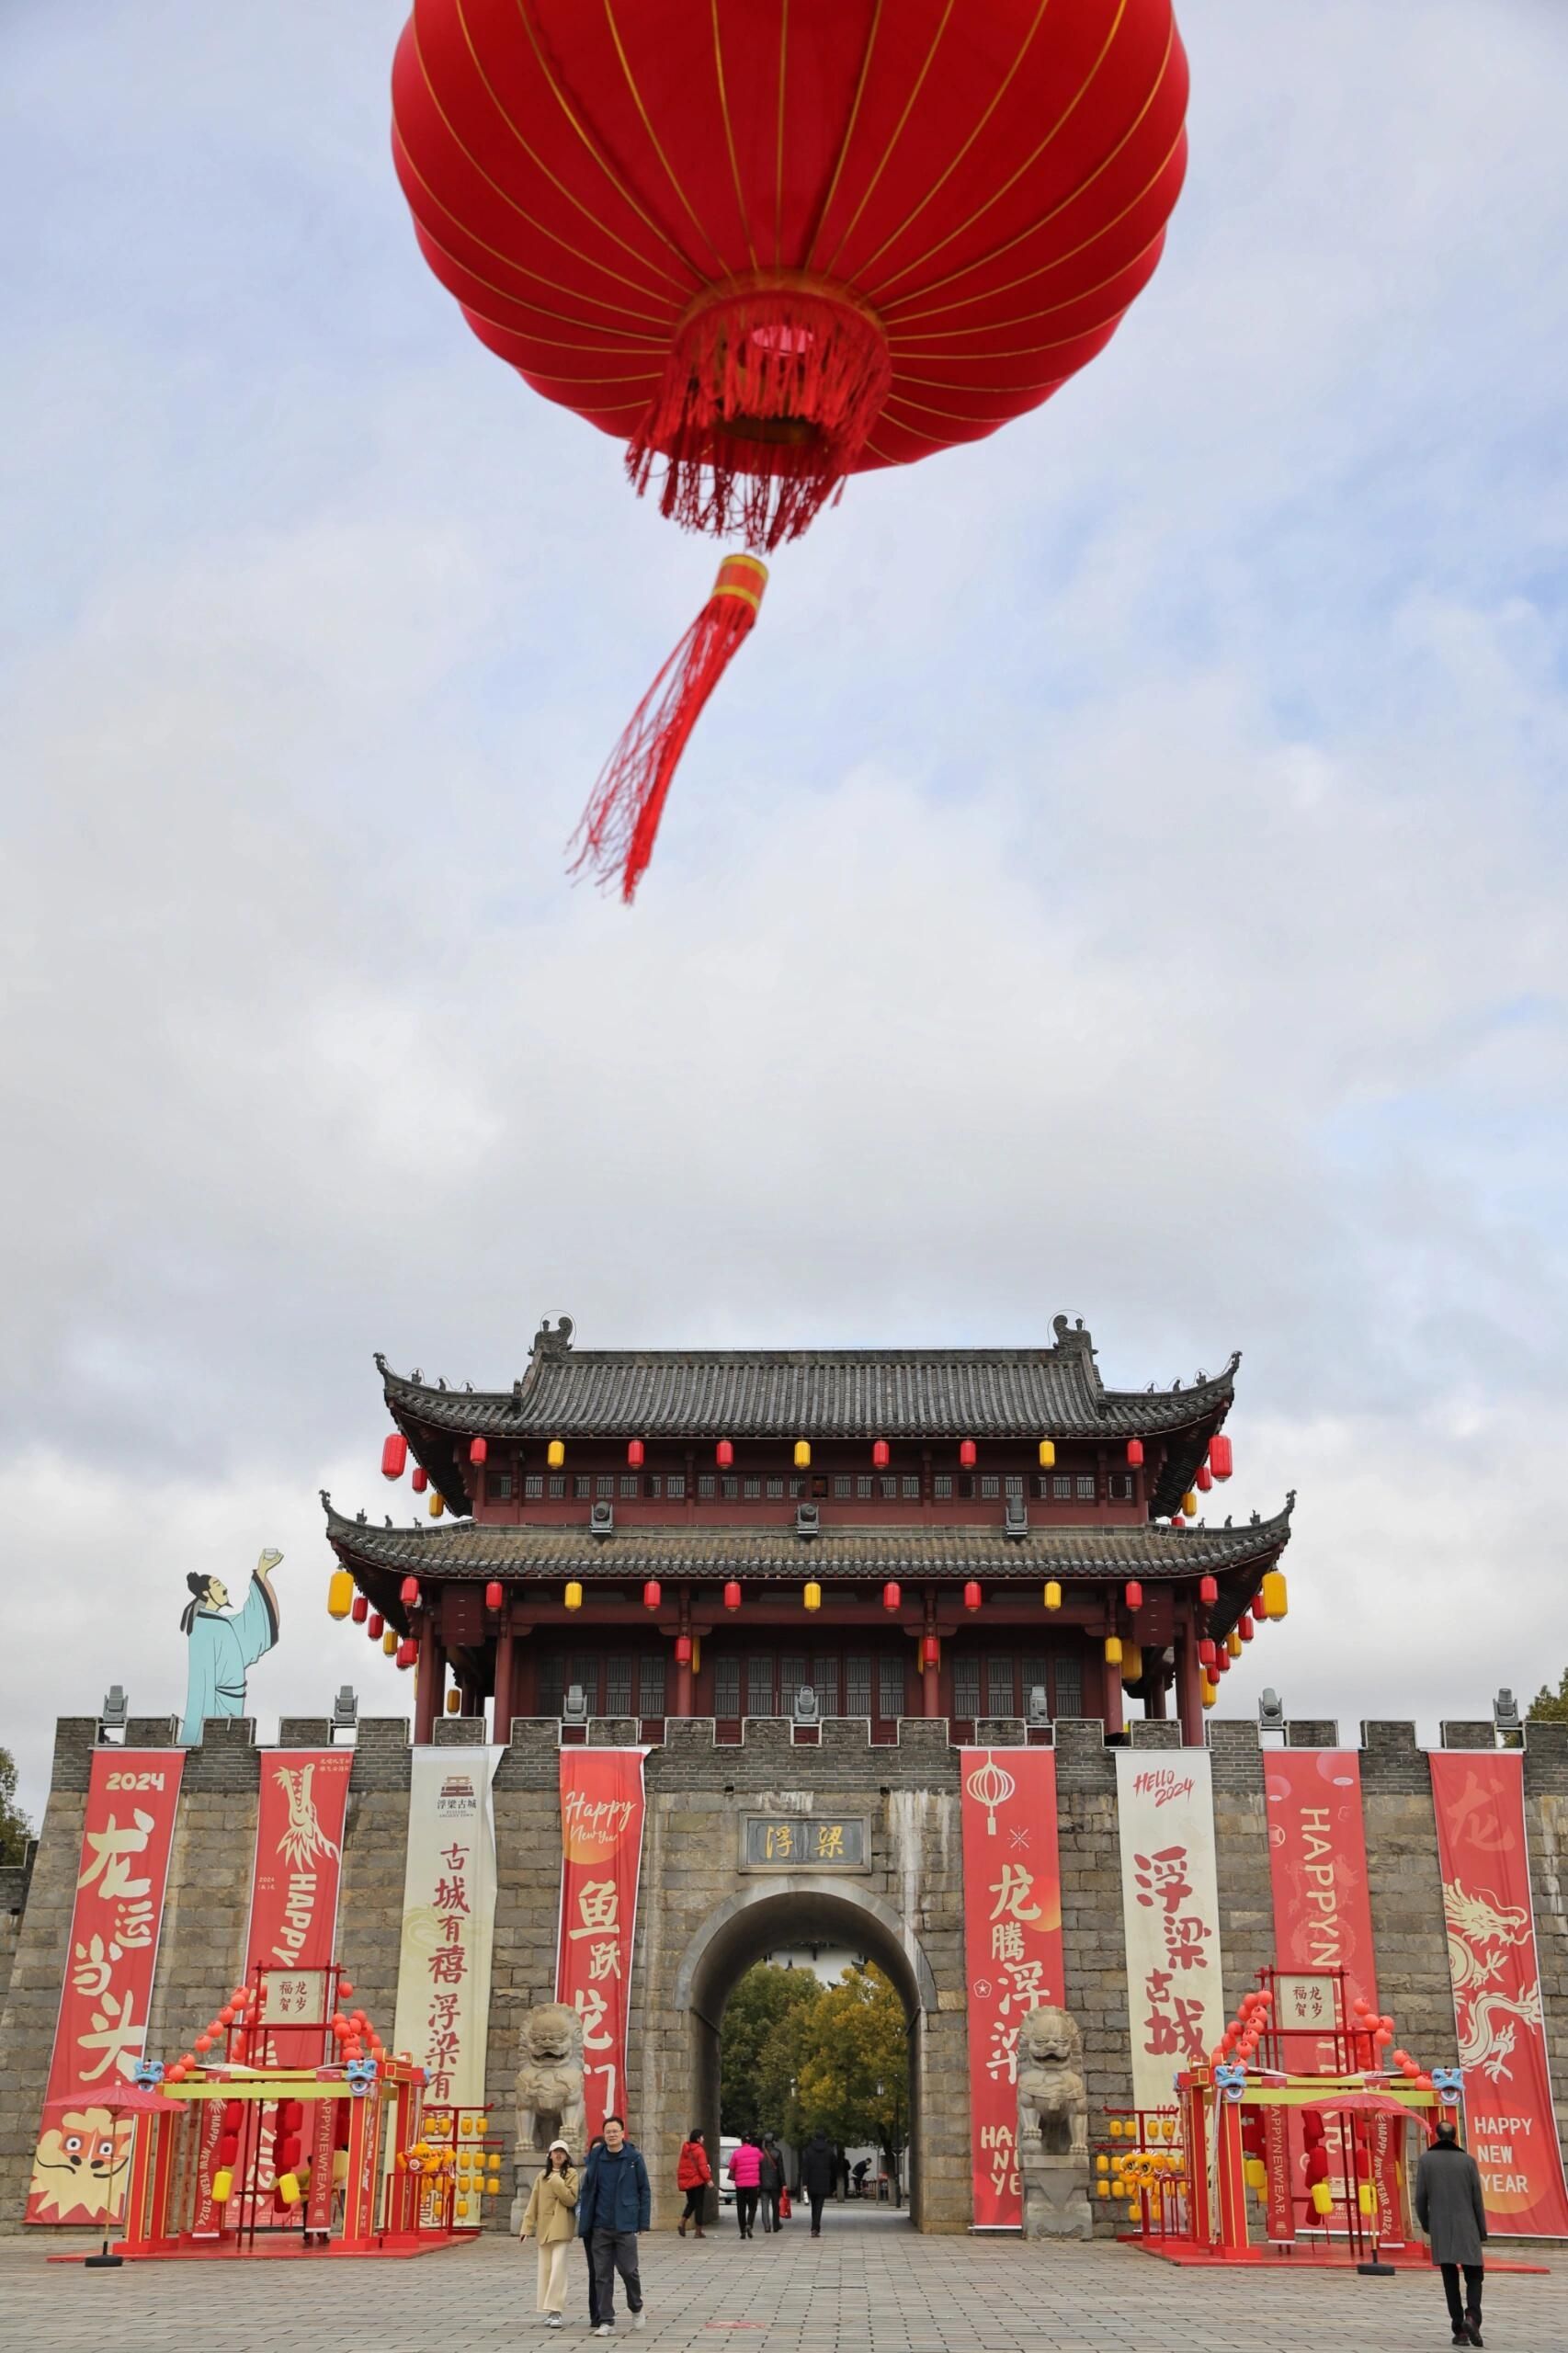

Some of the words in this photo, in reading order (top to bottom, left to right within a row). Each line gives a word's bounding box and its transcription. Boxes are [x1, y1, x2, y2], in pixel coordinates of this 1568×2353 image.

[106, 1772, 165, 1791] 2024
[1132, 1769, 1175, 1798] HELLO
[1154, 1778, 1195, 1808] 2024
[565, 1790, 637, 1832] Happy
[1447, 1770, 1516, 1851] 龙
[571, 1824, 596, 1843] New
[595, 1830, 619, 1844] Year
[272, 1873, 317, 1967] HAPPY
[1134, 1846, 1212, 2063] 浮梁古城
[206, 2115, 221, 2148] HAPPY
[1376, 2123, 1387, 2156] HAPPY
[1473, 2116, 1532, 2135] HAPPY
[199, 2147, 211, 2170] NEW
[315, 2097, 332, 2202] APPYNEWYEAR
[1477, 2144, 1513, 2164] NEW
[199, 2171, 211, 2197] YEAR
[1376, 2180, 1390, 2207] YEAR
[1480, 2174, 1528, 2193] YEAR
